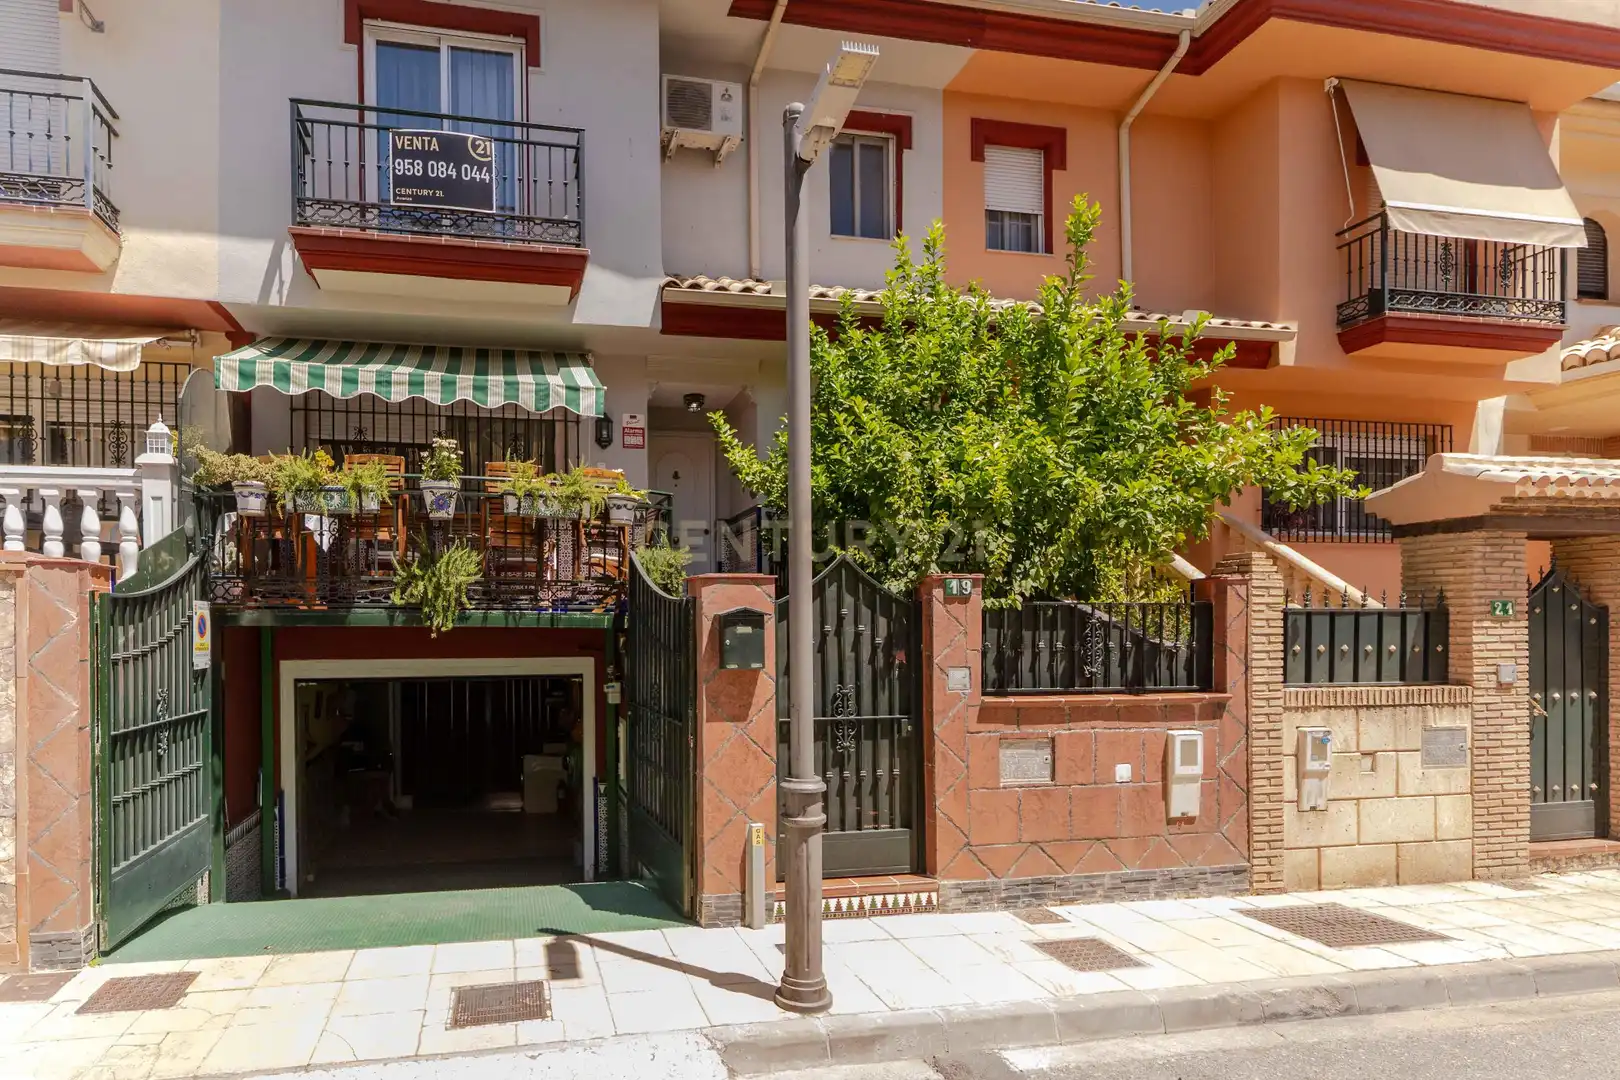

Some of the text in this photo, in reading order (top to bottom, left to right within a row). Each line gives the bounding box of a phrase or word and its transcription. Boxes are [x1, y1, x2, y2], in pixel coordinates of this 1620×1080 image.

[395, 135, 440, 152] VENTA
[475, 140, 491, 156] 21
[394, 158, 490, 184] 958 084 044
[395, 187, 434, 197] CENTURY
[949, 580, 972, 595] 19
[1494, 601, 1513, 615] 21
